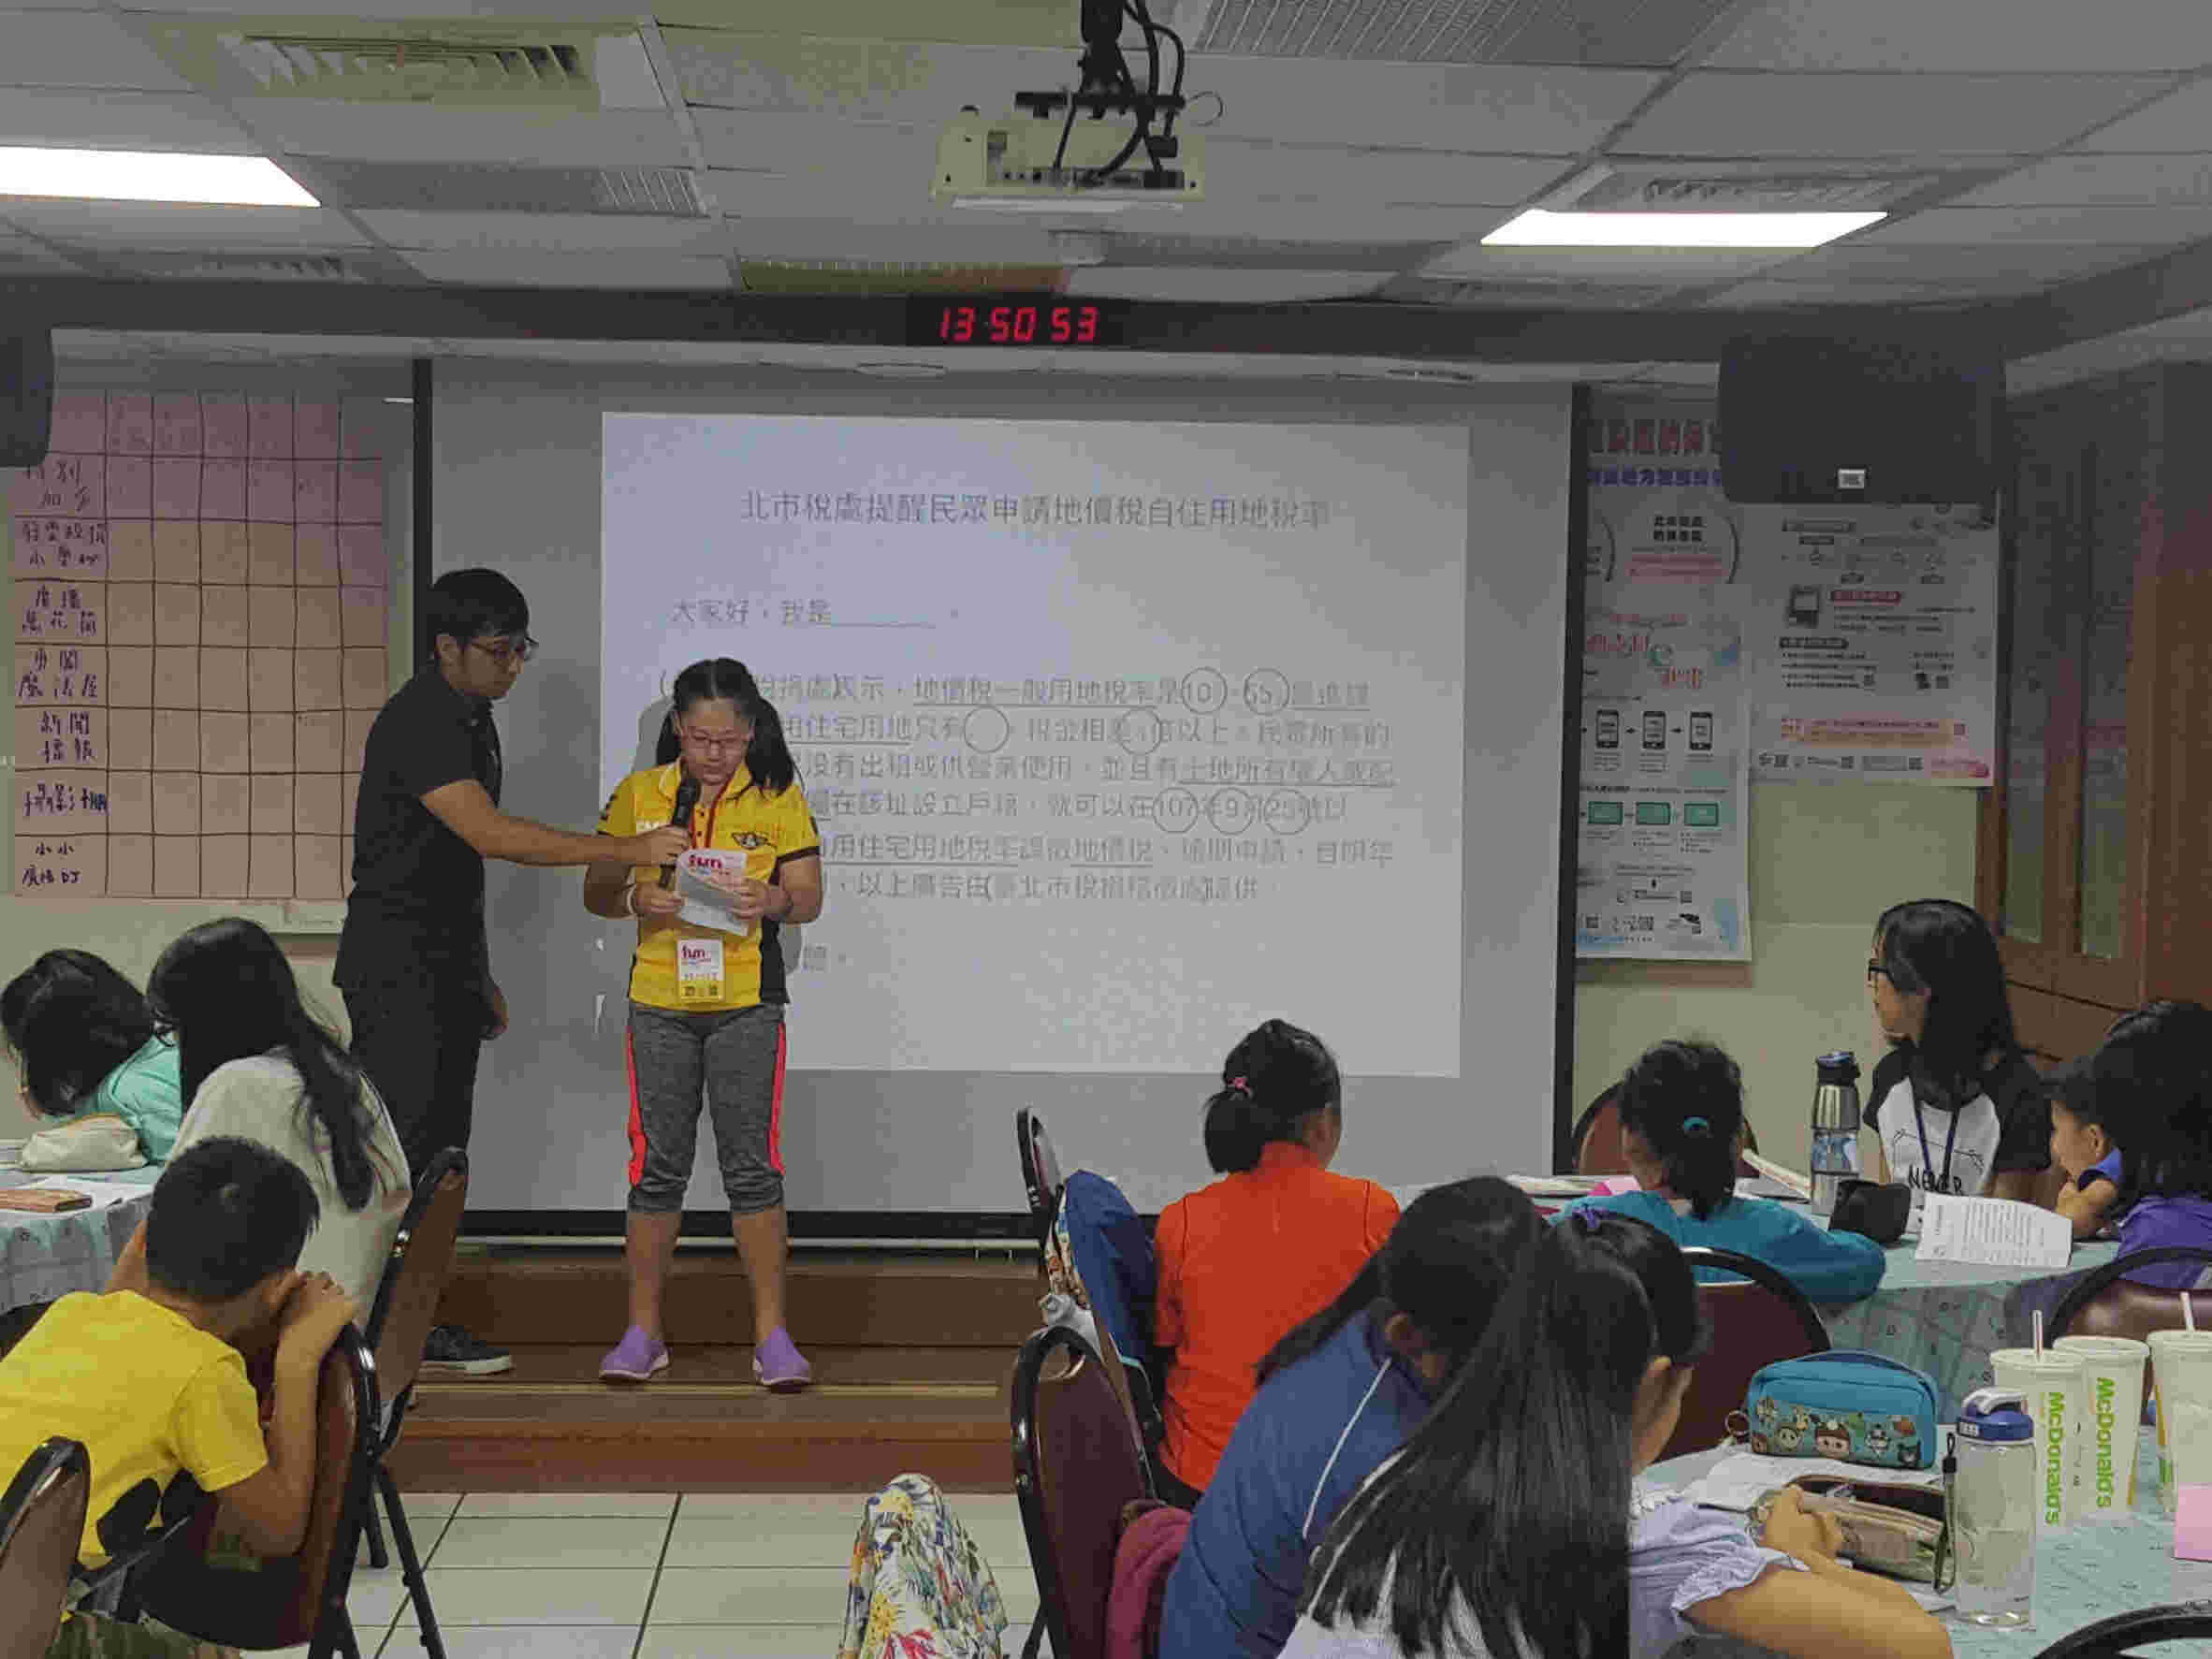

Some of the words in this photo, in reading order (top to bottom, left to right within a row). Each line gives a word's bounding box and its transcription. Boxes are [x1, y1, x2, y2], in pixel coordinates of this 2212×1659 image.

[939, 307, 976, 342] 13
[989, 307, 1041, 342] 50
[1049, 307, 1100, 342] 53
